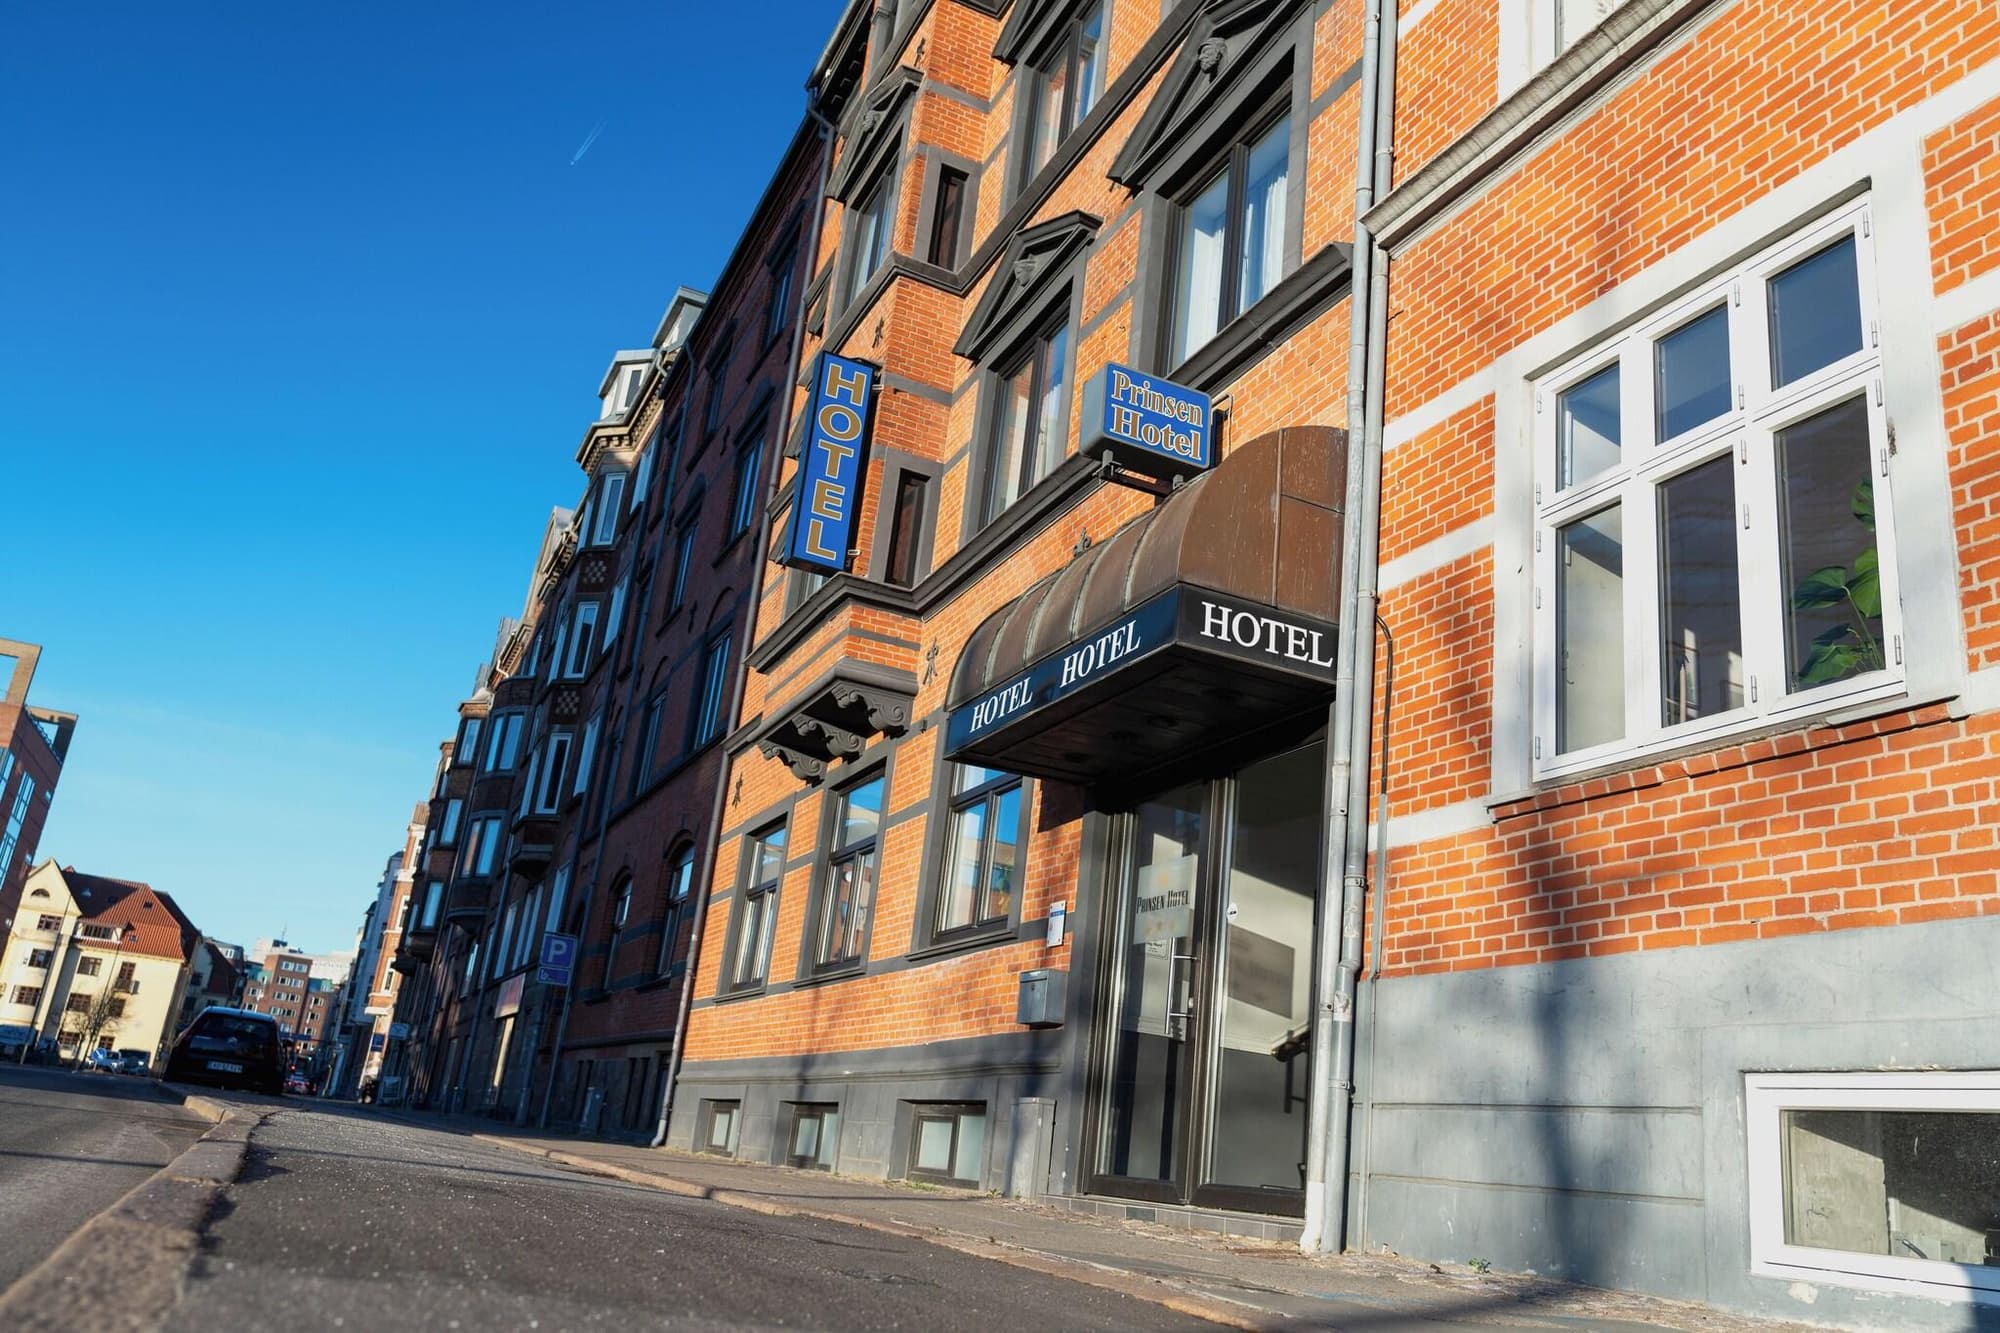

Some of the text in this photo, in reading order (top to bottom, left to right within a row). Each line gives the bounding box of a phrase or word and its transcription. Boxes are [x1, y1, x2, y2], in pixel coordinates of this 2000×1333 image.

[1111, 370, 1204, 428] Prinsen
[806, 363, 868, 561] HOTEL
[1110, 404, 1202, 461] Hotel
[1200, 601, 1334, 668] HOTEL
[969, 620, 1141, 734] HOTEL HOTEL
[547, 939, 567, 963] P
